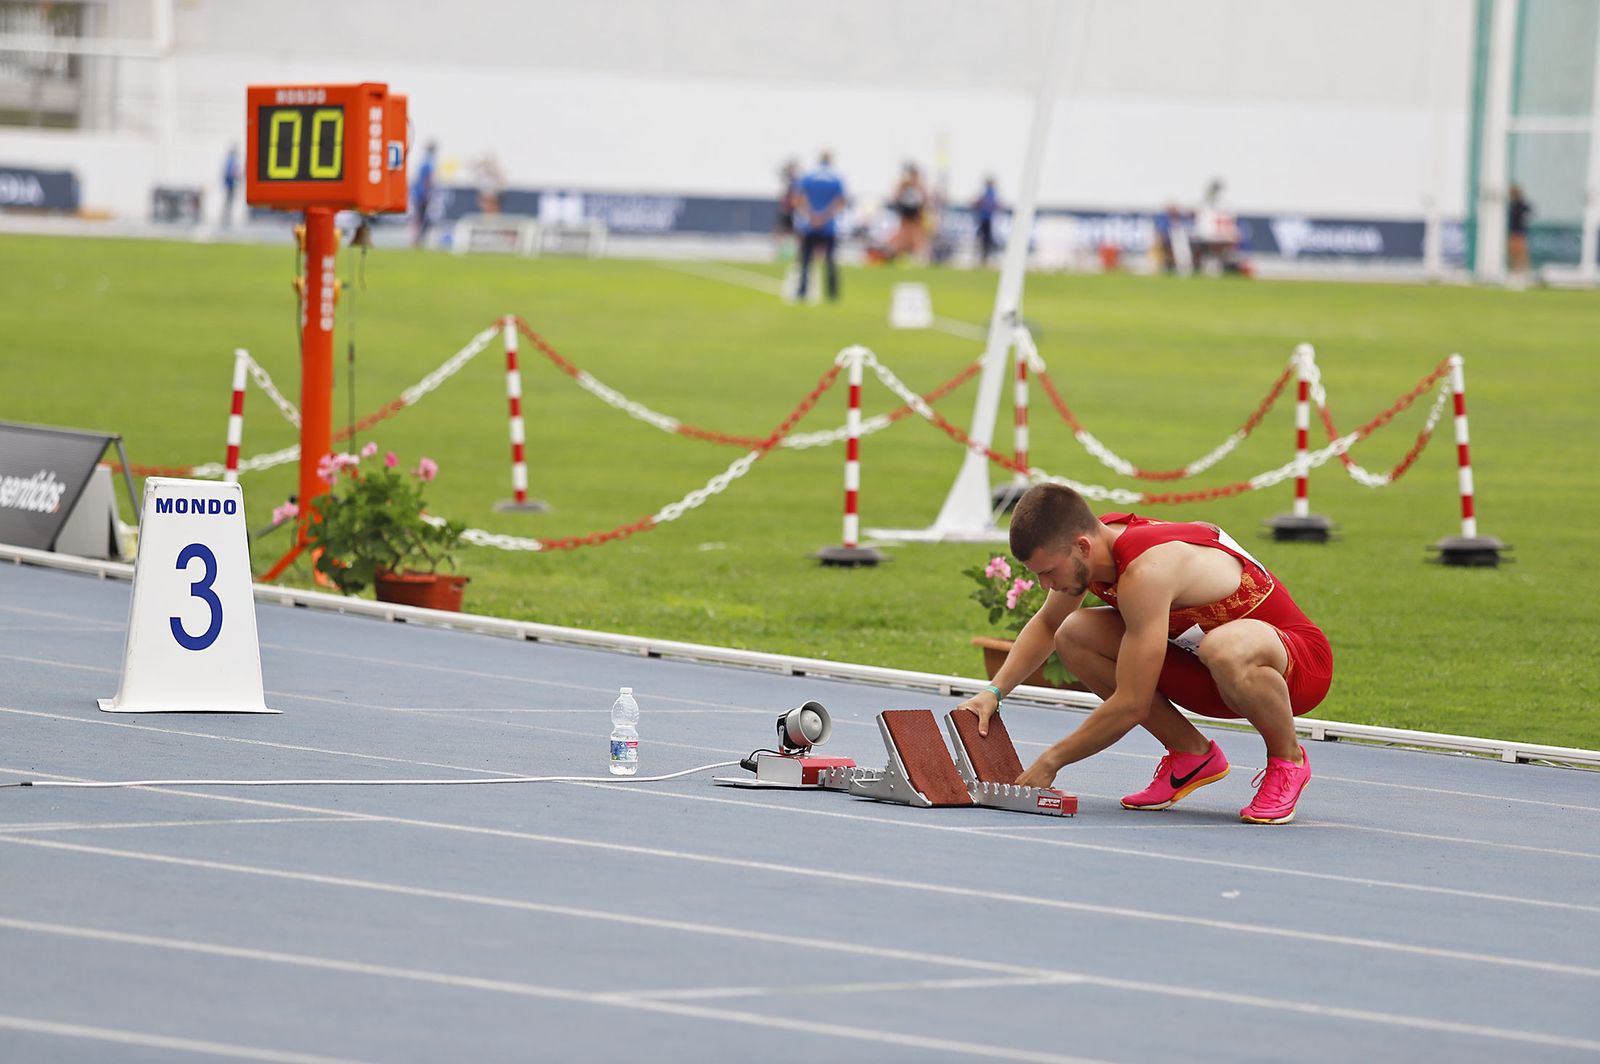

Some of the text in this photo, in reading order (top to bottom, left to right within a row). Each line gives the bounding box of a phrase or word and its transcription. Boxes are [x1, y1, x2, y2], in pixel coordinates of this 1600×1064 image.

[276, 89, 326, 104] MONDO
[267, 110, 344, 179] 00
[368, 107, 383, 184] MONDO
[155, 497, 237, 516] MONDO
[169, 543, 223, 651] 3
